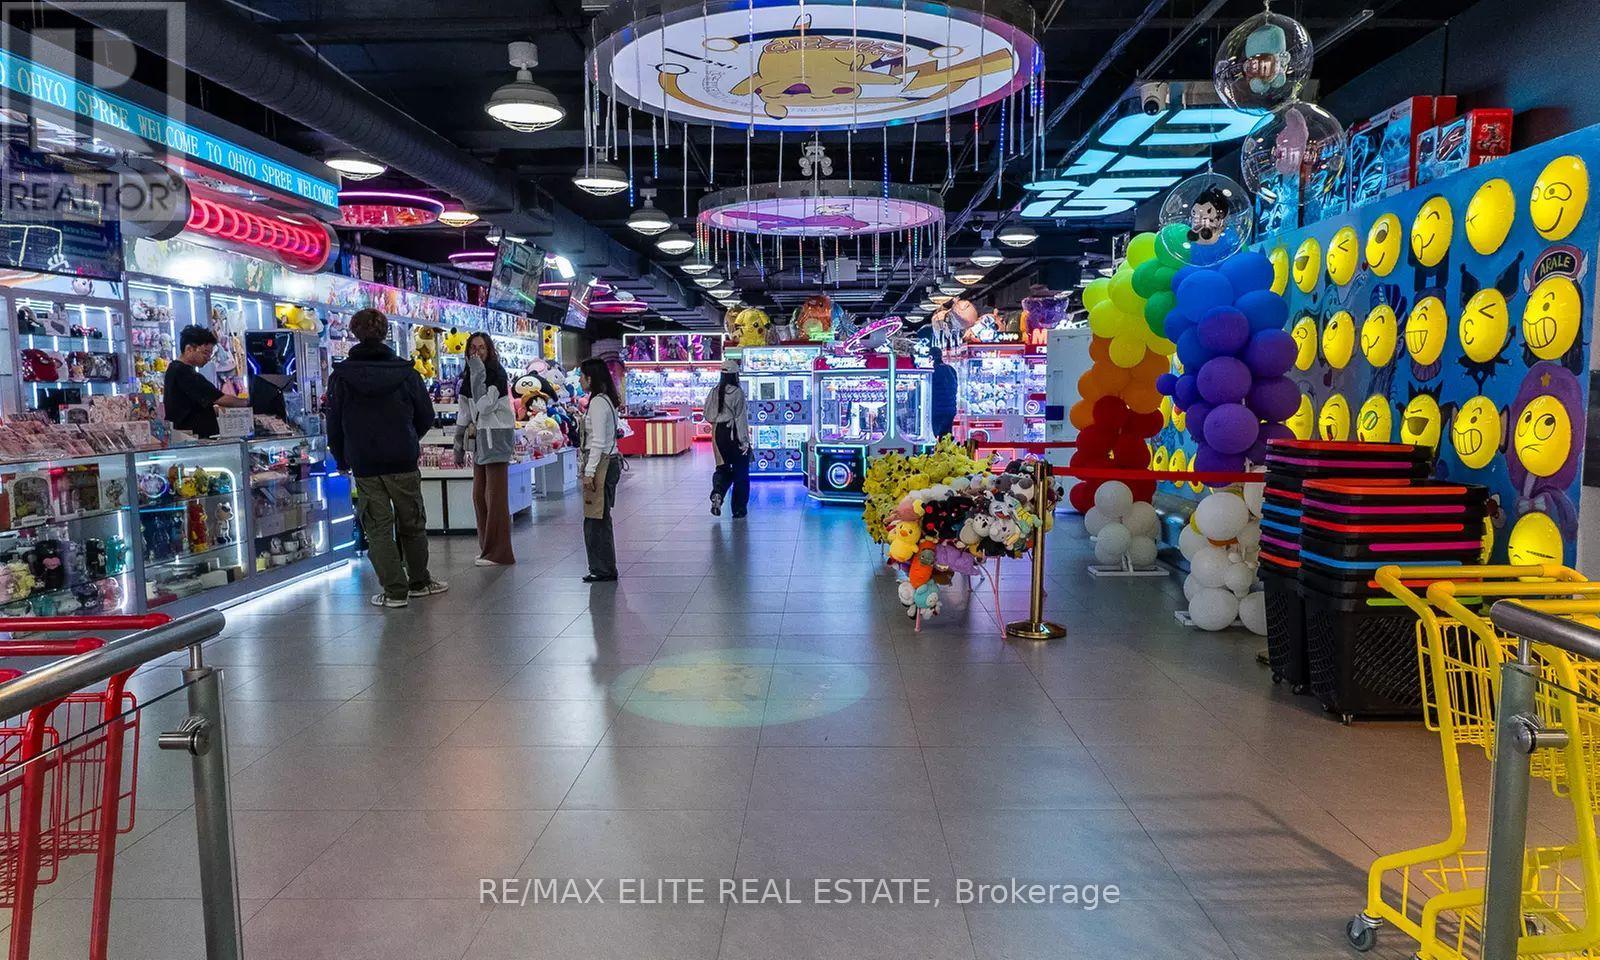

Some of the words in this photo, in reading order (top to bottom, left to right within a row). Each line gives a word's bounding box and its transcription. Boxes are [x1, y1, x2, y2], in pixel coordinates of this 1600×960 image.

[17, 67, 67, 107] OHYO
[77, 90, 130, 131] SPREE
[137, 113, 200, 156] WELCOME
[205, 141, 222, 165] TO
[228, 150, 256, 178] OHYO
[262, 163, 293, 192] SPREE
